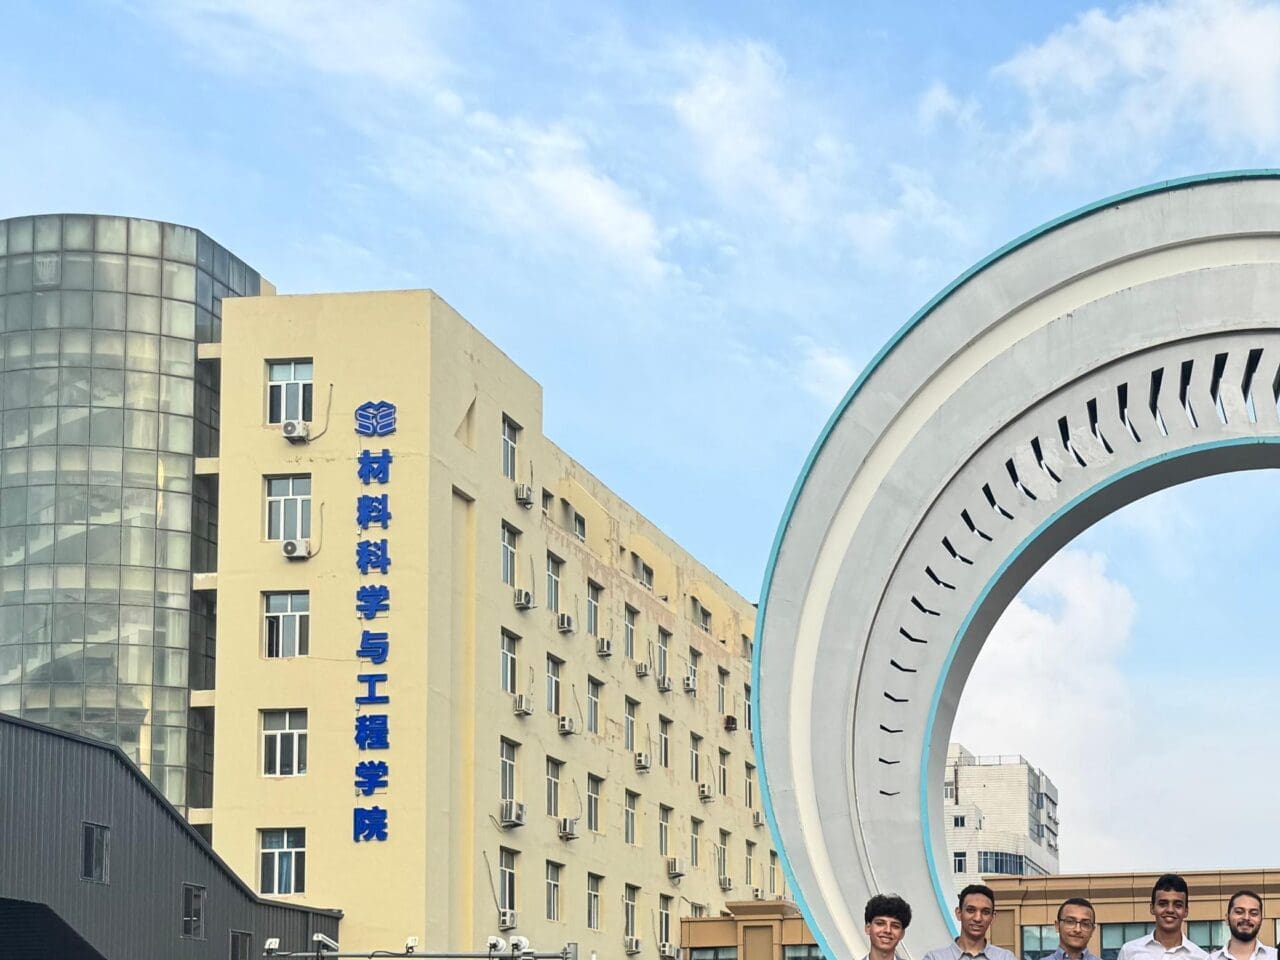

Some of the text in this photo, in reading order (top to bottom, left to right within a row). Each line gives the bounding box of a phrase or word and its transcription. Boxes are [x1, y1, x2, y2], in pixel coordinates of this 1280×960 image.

[353, 449, 393, 842] 材料科学与工程学院
